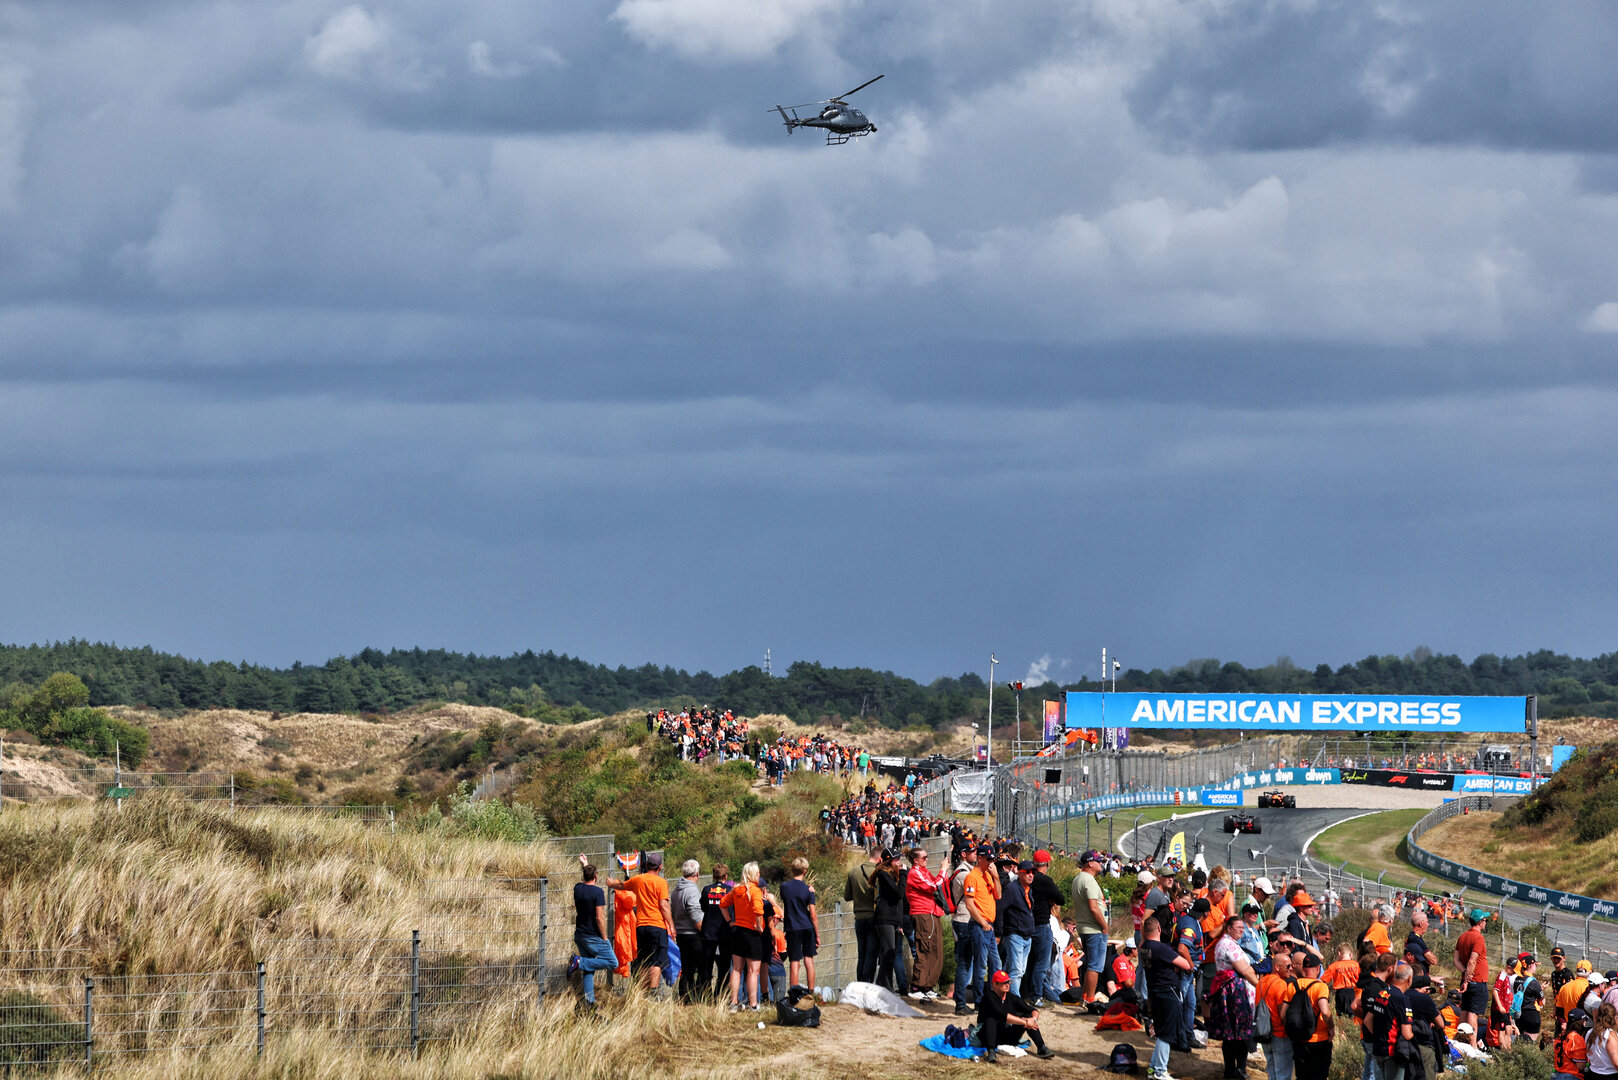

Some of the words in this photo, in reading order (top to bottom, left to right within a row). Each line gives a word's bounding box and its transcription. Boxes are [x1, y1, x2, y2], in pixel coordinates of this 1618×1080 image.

[1131, 700, 1301, 723] AMERICAN
[1312, 701, 1462, 725] EXPRESS
[1305, 768, 1332, 784] allwyn
